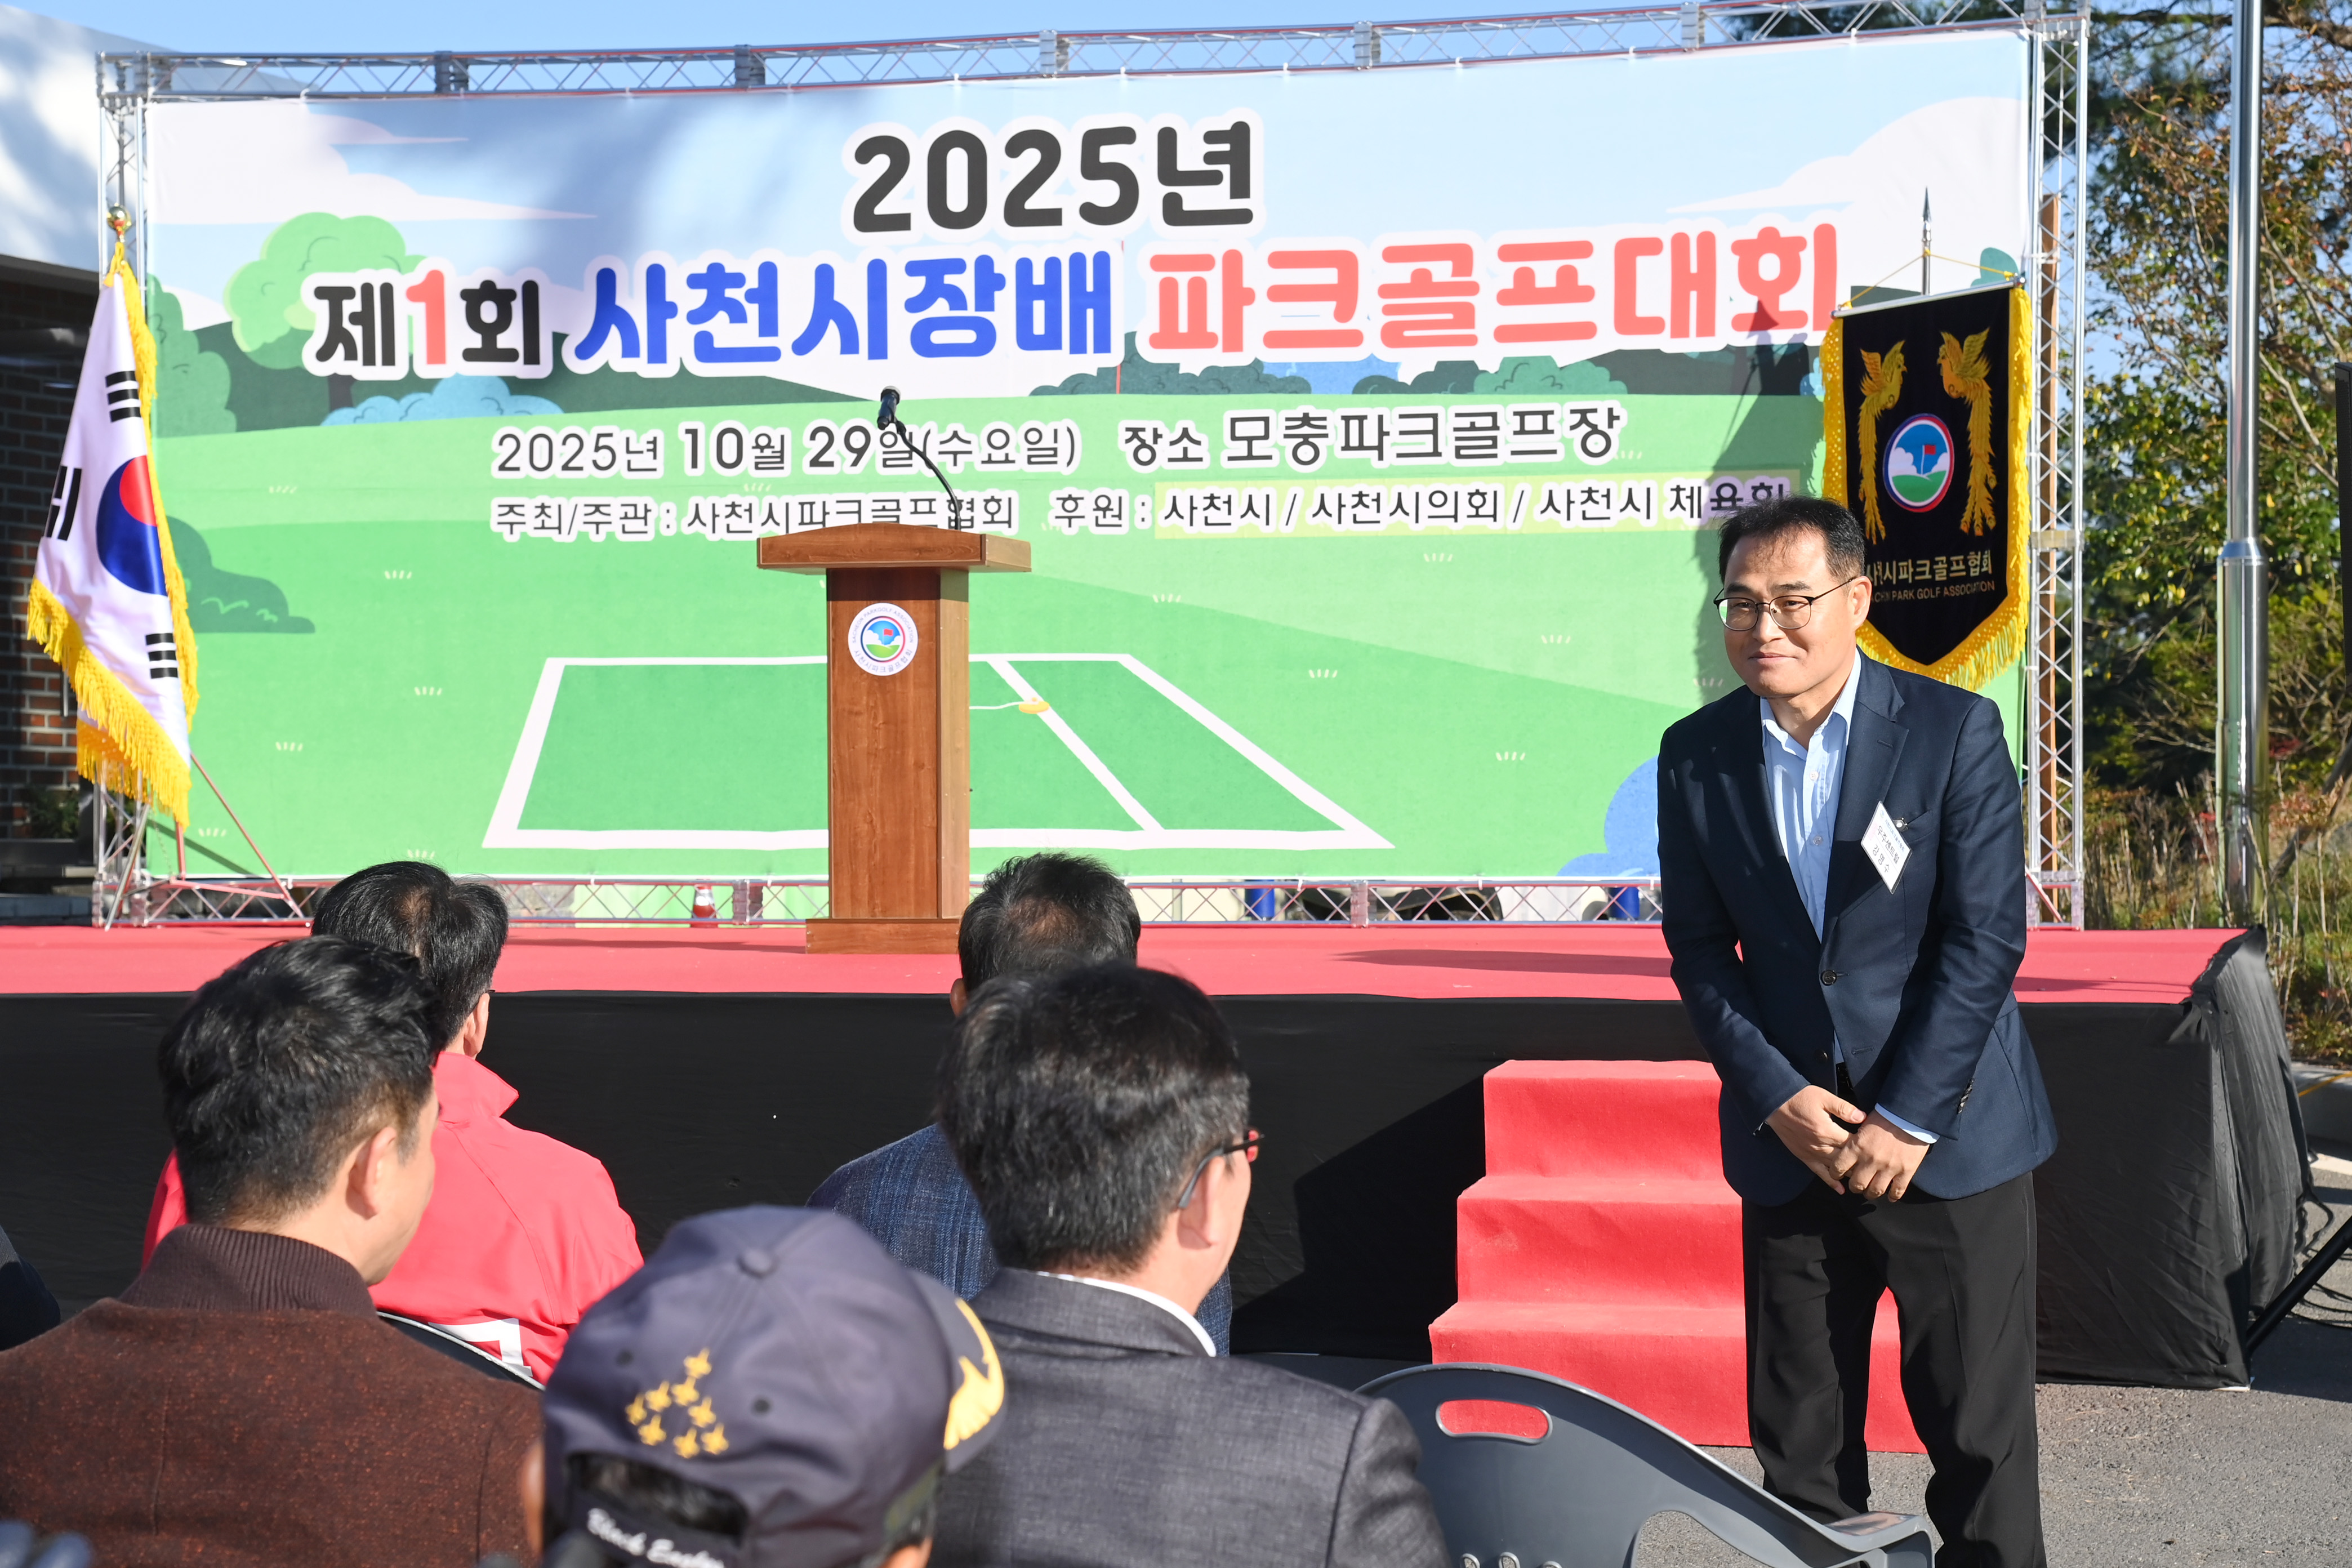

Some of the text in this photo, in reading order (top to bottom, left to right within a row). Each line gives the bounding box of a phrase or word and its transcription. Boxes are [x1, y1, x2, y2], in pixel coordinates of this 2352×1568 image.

[853, 120, 1254, 233] 2025년
[313, 223, 1838, 367] 제1회 사천시장배 파크골프대회
[497, 406, 1621, 472] 2025년 10월 29일(수요일) 장소 모충파크골프장
[1164, 493, 1270, 527] 사천시
[1312, 488, 1498, 524] 사천시의회
[1540, 486, 1651, 521] 사천시
[1892, 589, 1915, 601] PARK
[1917, 586, 1941, 600] GOLF
